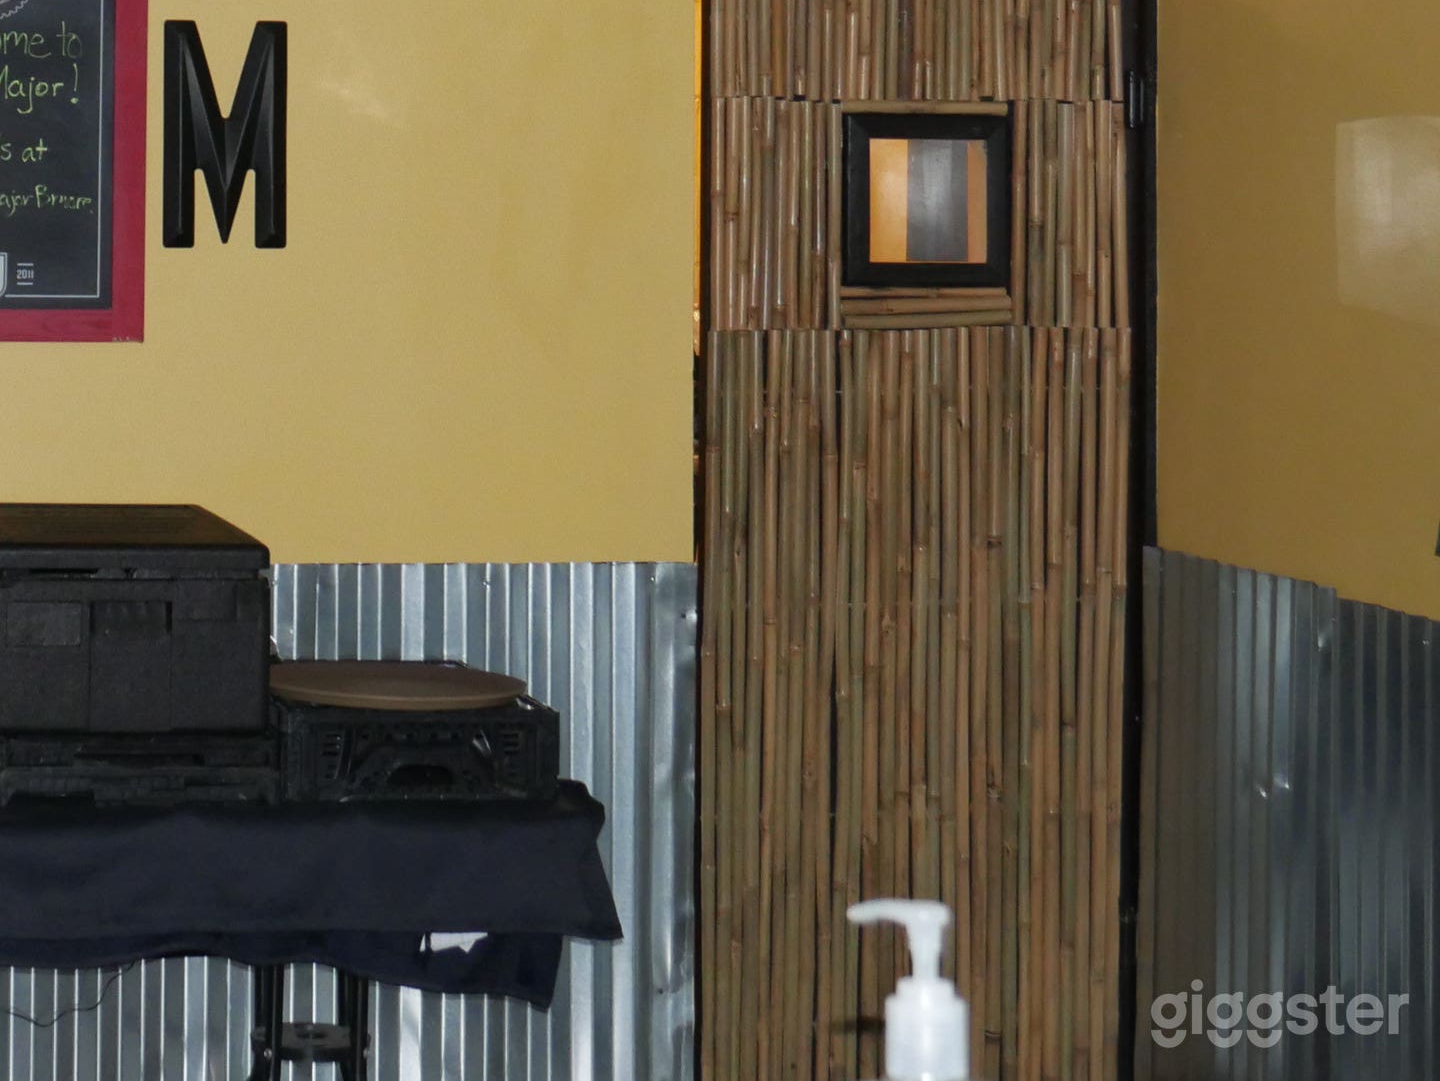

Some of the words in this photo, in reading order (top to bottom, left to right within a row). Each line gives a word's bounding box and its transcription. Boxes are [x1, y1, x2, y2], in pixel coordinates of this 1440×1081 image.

[162, 20, 288, 249] M
[21, 137, 49, 163] at
[16, 269, 34, 280] 2011
